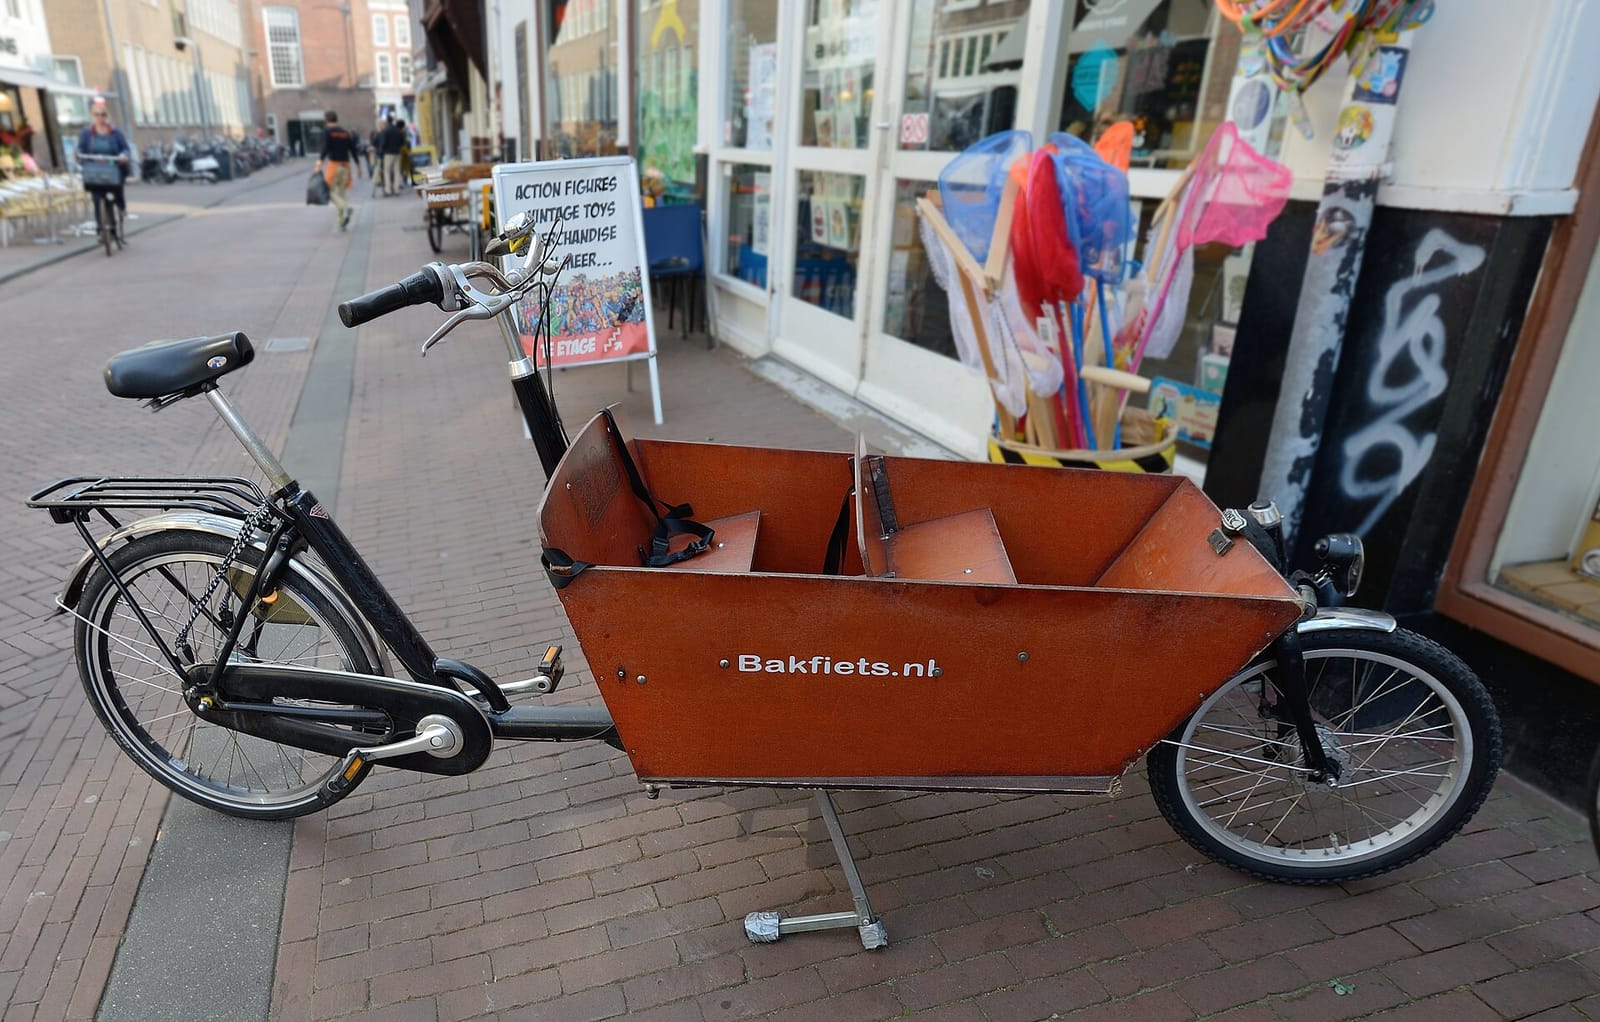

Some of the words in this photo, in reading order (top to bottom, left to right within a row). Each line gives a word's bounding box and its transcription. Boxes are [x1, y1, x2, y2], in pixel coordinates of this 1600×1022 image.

[515, 182, 561, 201] ACTION
[565, 175, 617, 196] FIGURES
[583, 200, 616, 219] TOYS
[557, 336, 596, 357] ETAGE
[738, 654, 938, 678] Bakfiets.nl
